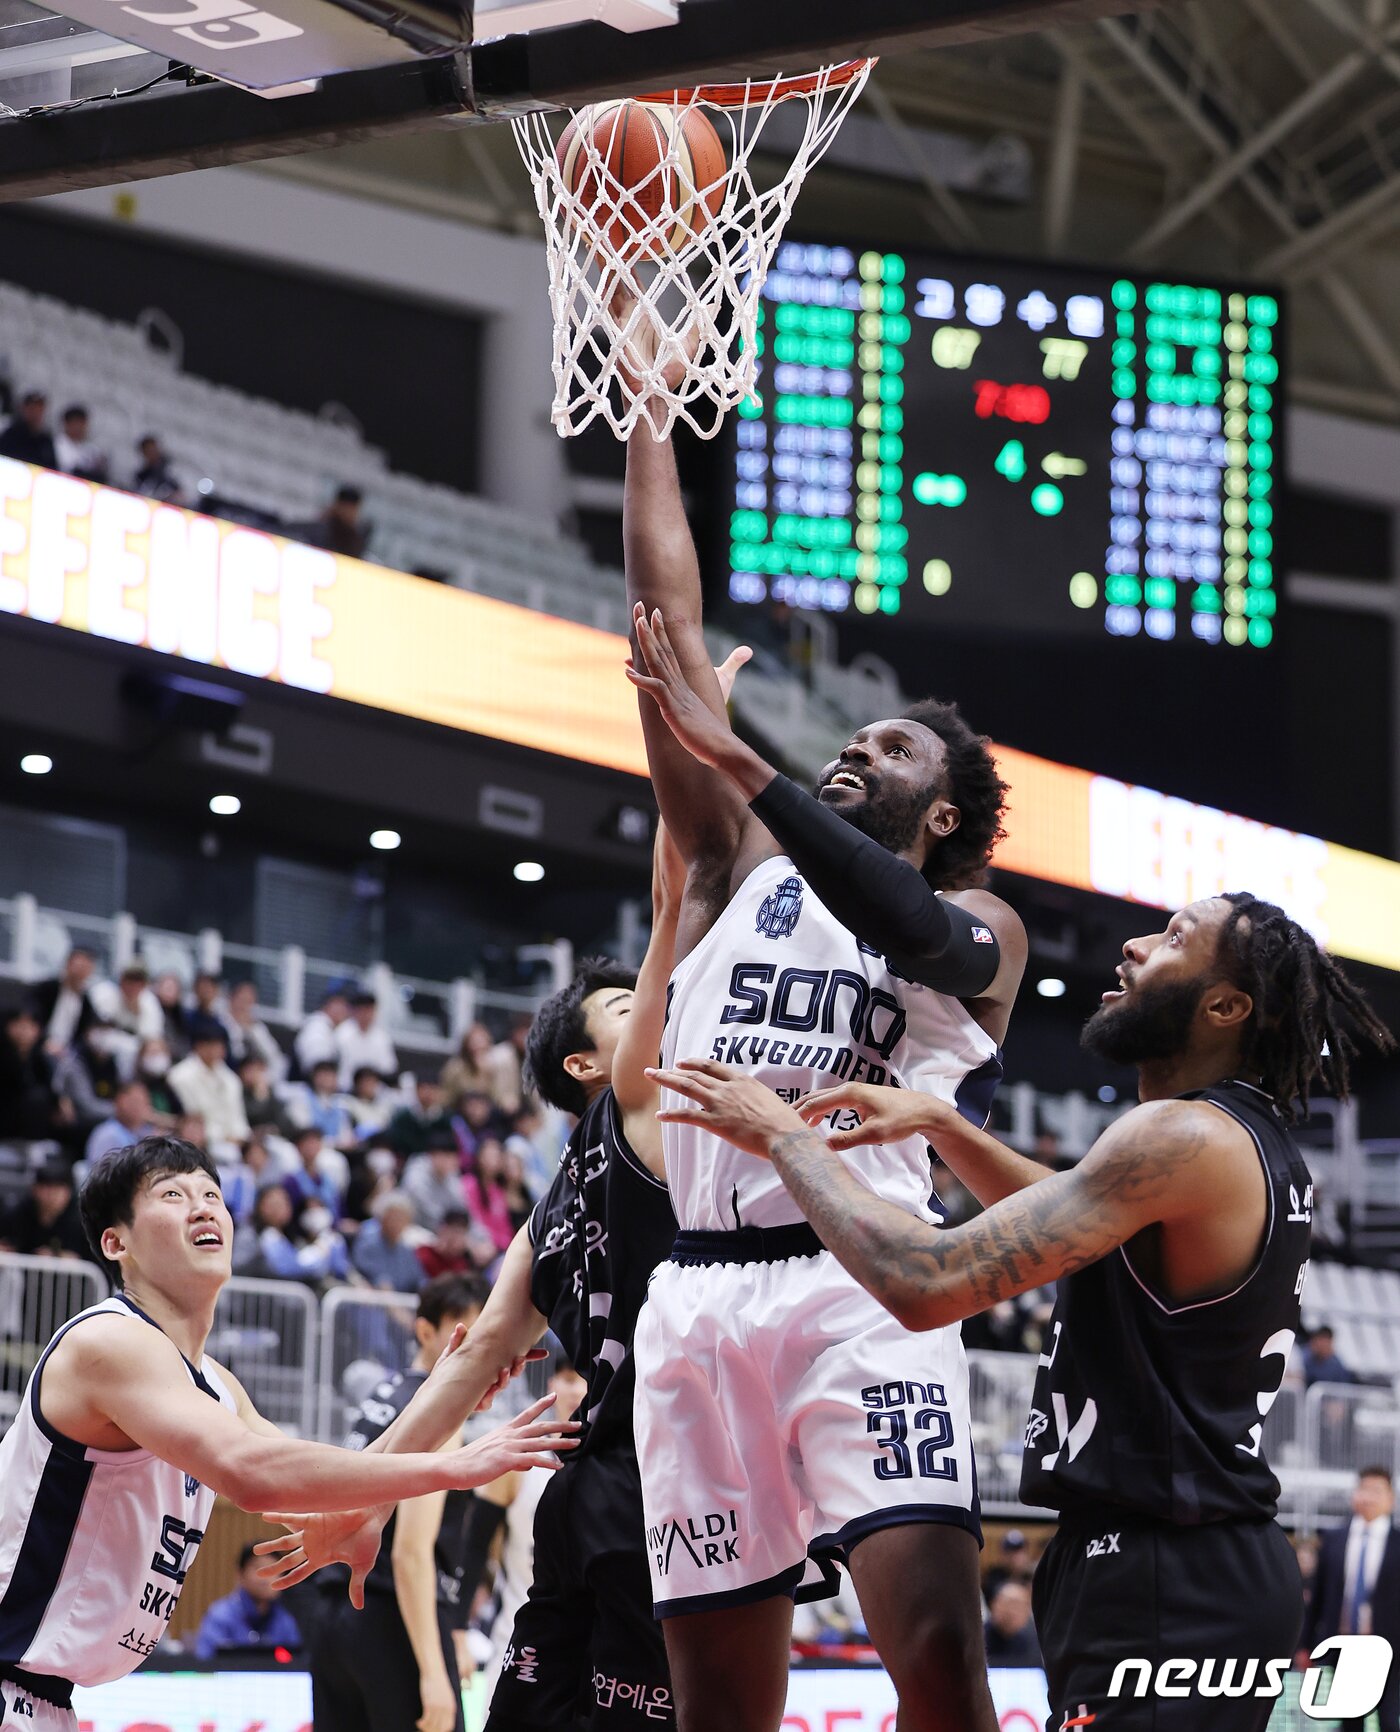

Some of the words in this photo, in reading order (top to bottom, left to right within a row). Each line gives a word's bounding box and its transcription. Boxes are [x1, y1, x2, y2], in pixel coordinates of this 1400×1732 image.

[867, 1408, 959, 1482] 32
[647, 1509, 737, 1571] VIVALDI
[656, 1527, 740, 1576] PARK
